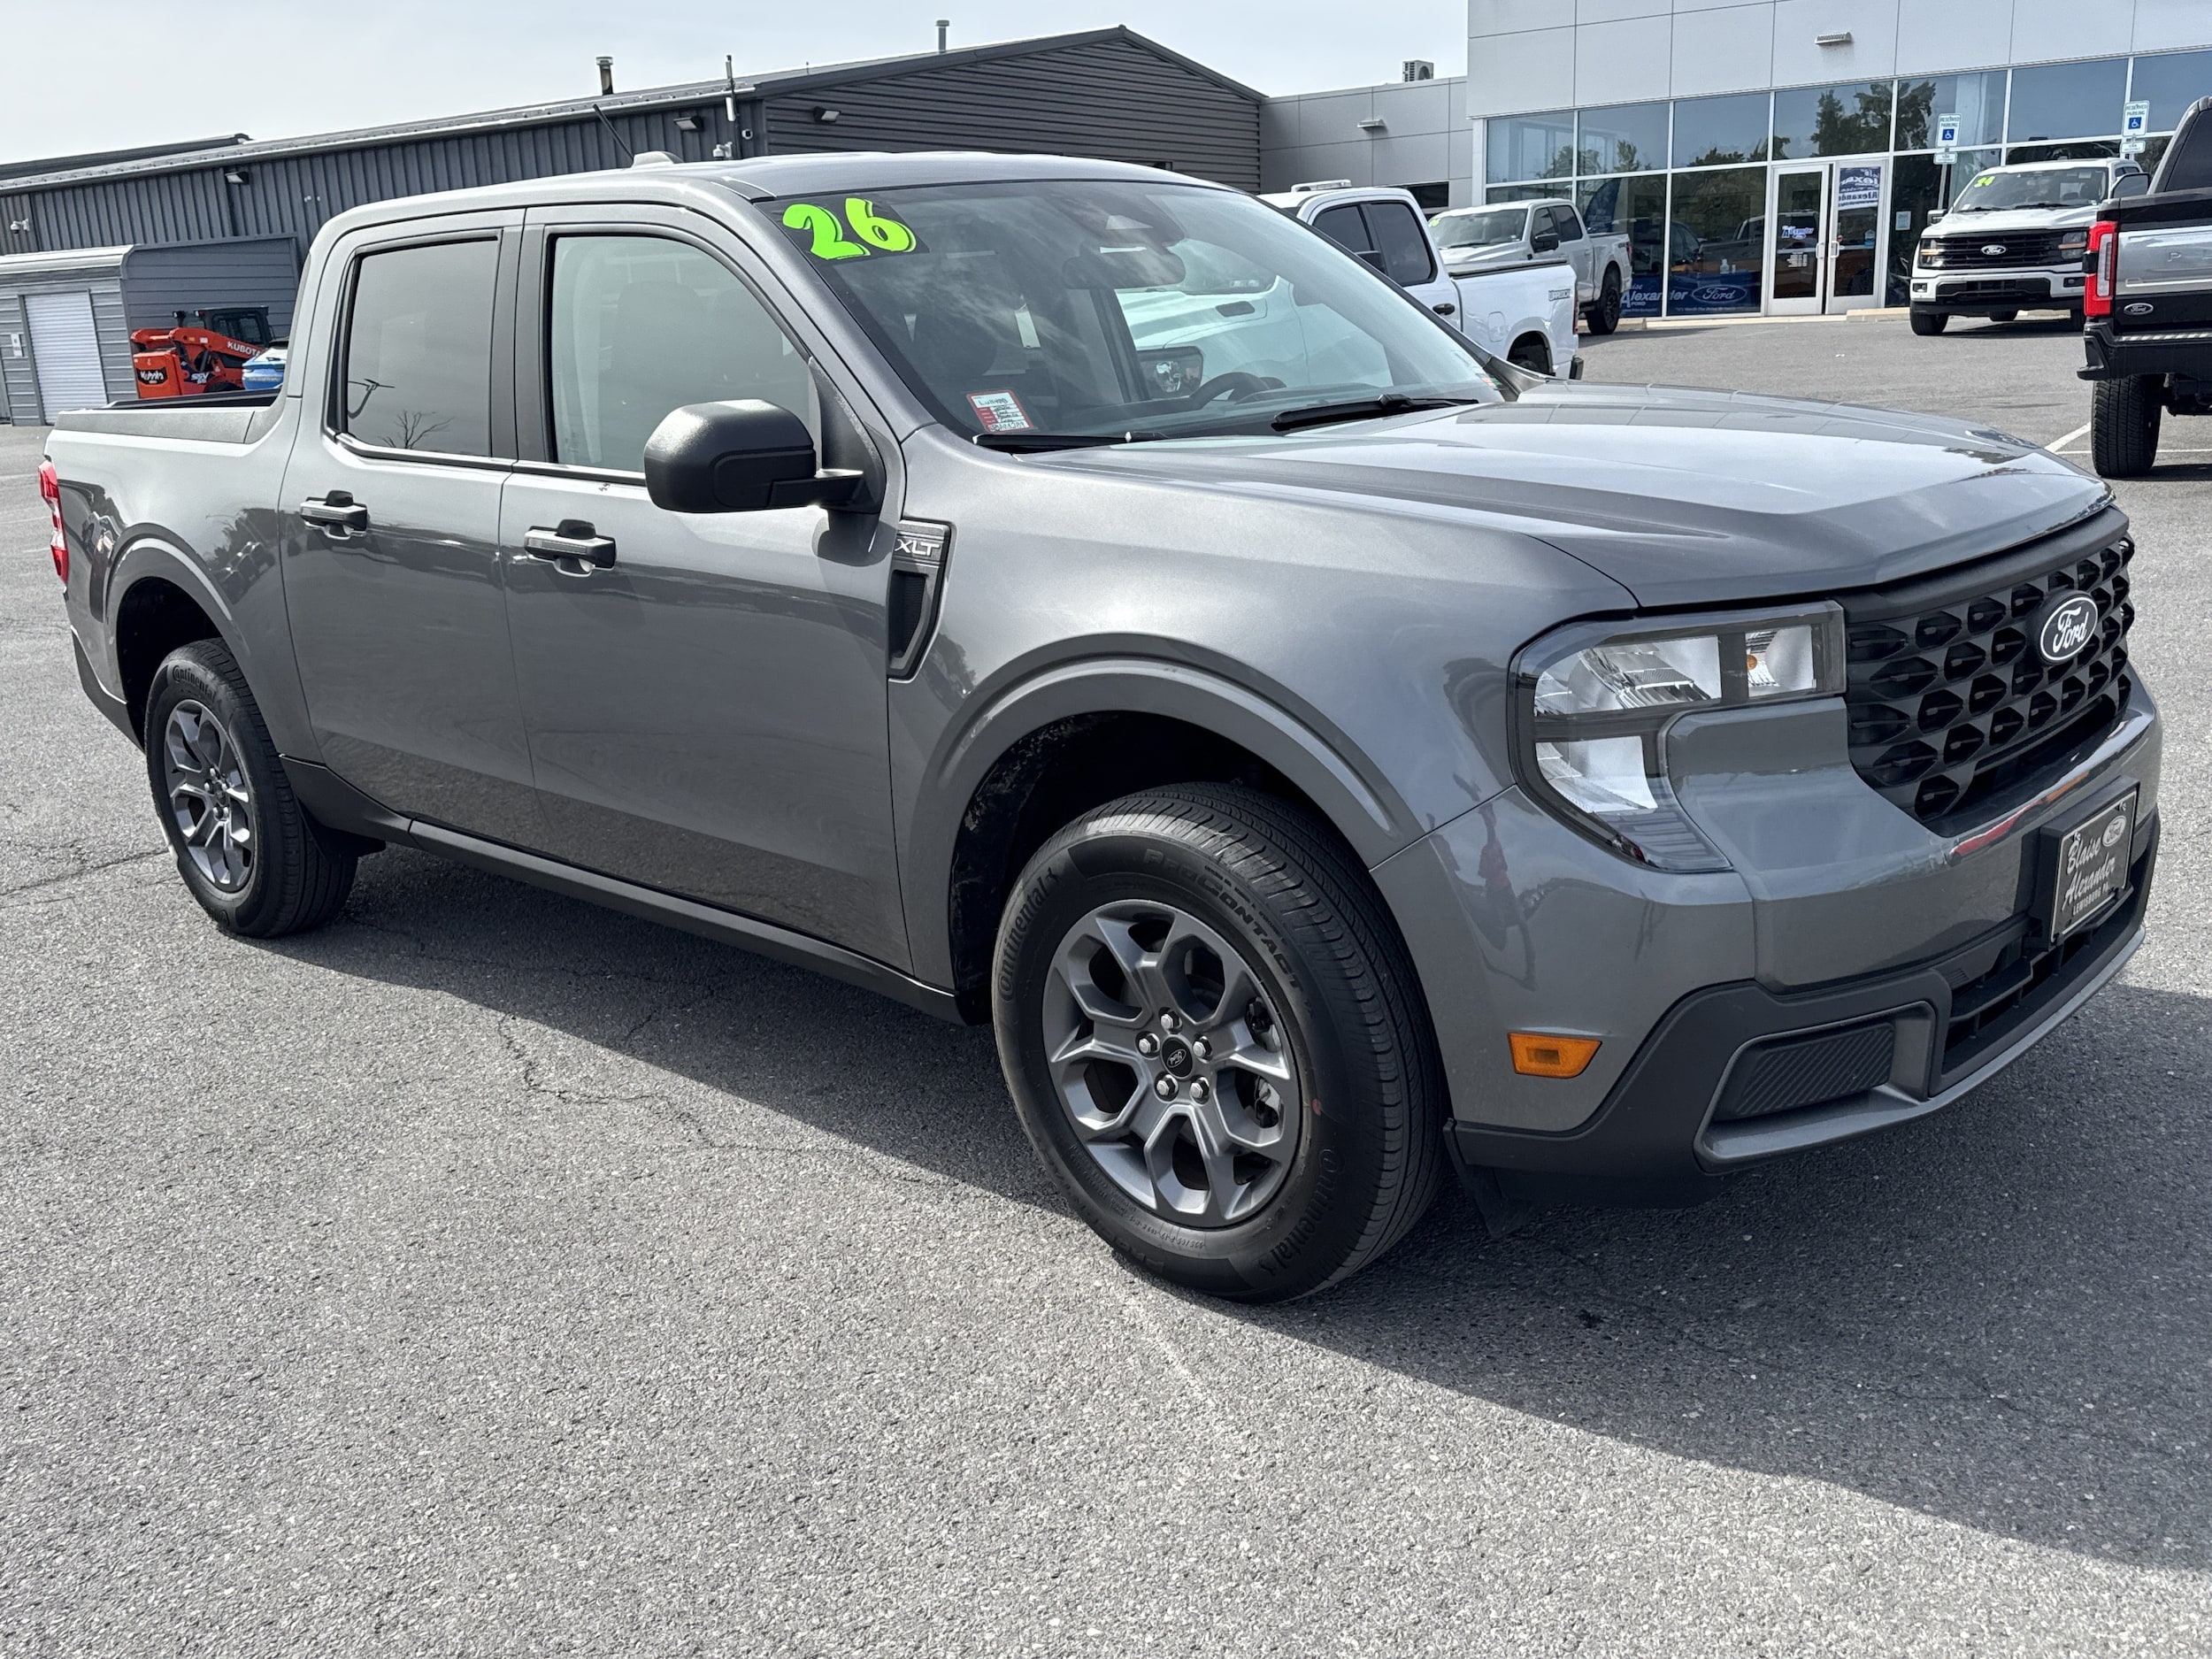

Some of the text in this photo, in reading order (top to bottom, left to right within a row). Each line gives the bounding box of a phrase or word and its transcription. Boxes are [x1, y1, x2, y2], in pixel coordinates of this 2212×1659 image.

[783, 198, 917, 260] 26
[1703, 287, 1735, 300] Ford
[895, 539, 940, 557] XLT
[173, 665, 217, 703] Continental
[2067, 836, 2101, 874] Blaise
[2062, 852, 2116, 911] Alexander
[997, 882, 1050, 1002] Continental
